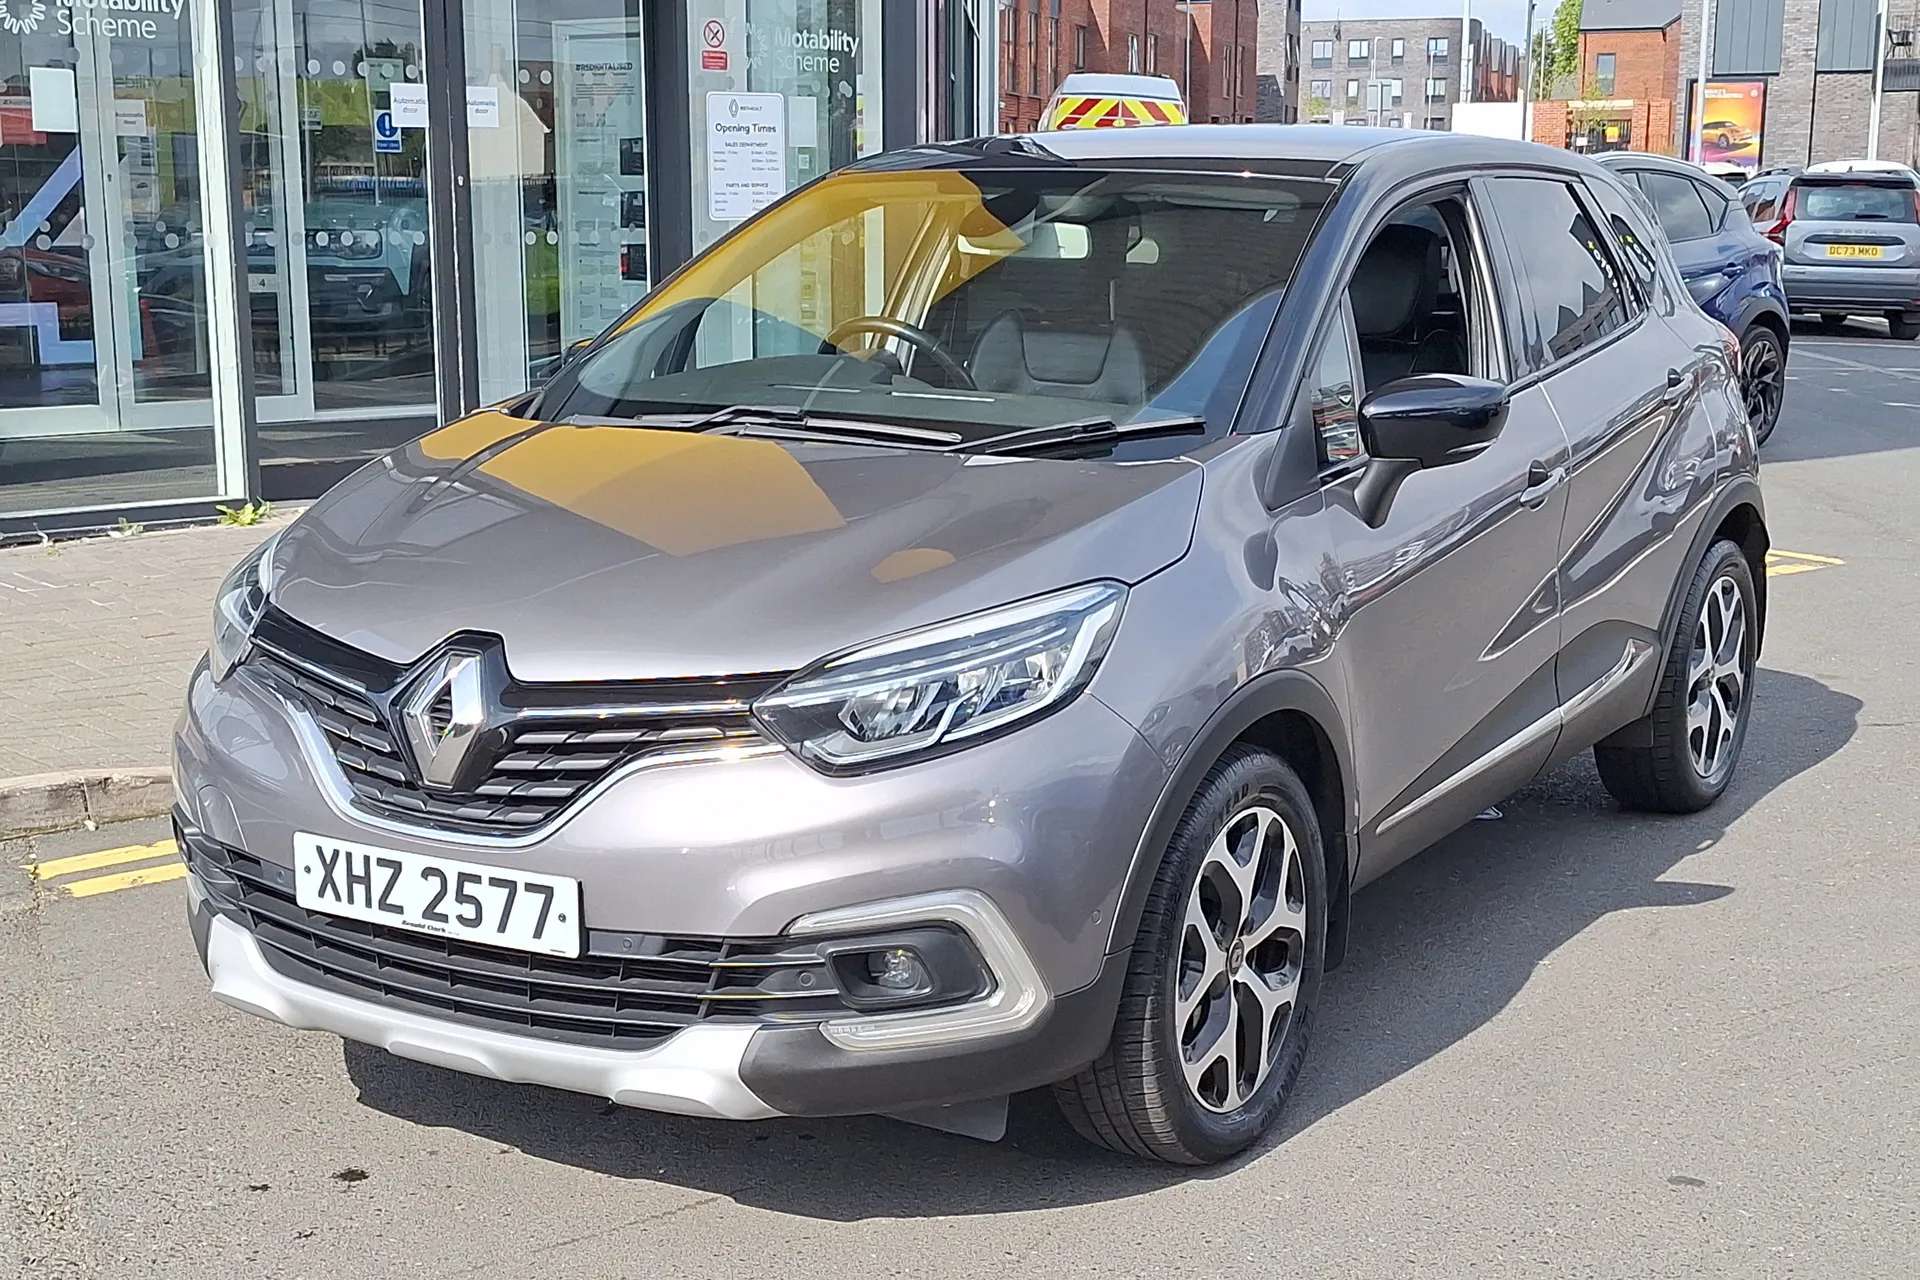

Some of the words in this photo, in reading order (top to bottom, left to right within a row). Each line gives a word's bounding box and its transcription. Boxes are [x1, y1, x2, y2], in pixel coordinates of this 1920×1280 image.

[55, 0, 184, 20] ability
[57, 9, 157, 39] Scheme
[775, 27, 859, 58] Motability
[777, 54, 840, 73] Scheme
[715, 122, 751, 136] Opening
[752, 123, 777, 133] Times
[1829, 246, 1856, 256] DC73
[315, 844, 405, 916] XHZ
[420, 865, 555, 940] 2577
